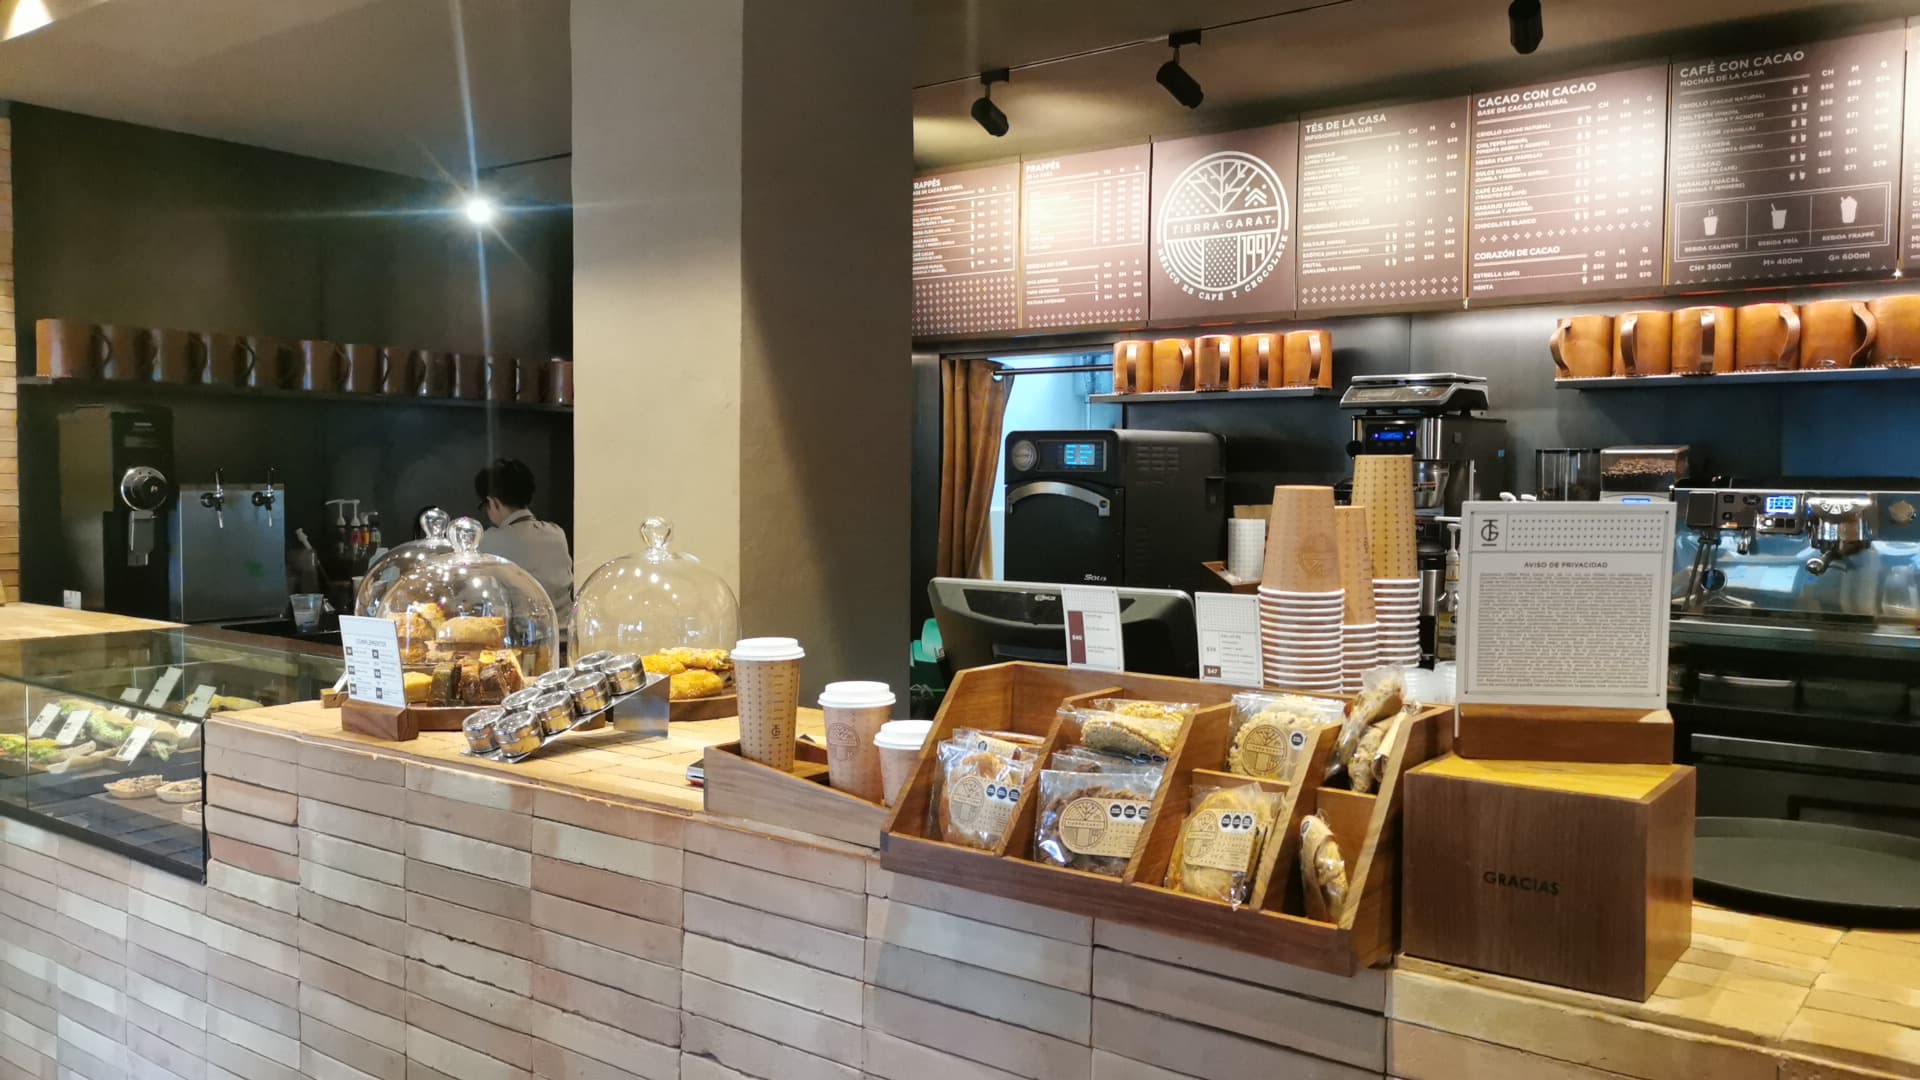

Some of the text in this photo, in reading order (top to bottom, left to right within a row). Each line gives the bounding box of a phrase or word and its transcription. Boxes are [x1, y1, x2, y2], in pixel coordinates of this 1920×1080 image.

[1680, 51, 1804, 78] CAFÉ CON CACAO
[1821, 68, 1834, 77] CH
[1851, 64, 1859, 72] M
[1680, 69, 1765, 87] MOCHAS DE LA CASA
[1478, 82, 1597, 108] CACAO CON CACAO
[1477, 97, 1569, 117] BASE DE CACAO NATURAL
[1305, 113, 1387, 134] TÉS DE LA CASA
[1408, 127, 1418, 135] CH
[1025, 160, 1061, 173] FRAPPÉS
[912, 177, 941, 190] RAPPÉS
[1173, 220, 1220, 235] TIERRA
[1822, 229, 1875, 242] BEBIDA FRAPPÉ
[1684, 242, 1739, 253] BEBIDA CALIENTE
[1757, 239, 1781, 248] BEBIDA
[1241, 233, 1272, 279] 1991
[1474, 245, 1560, 261] CORAZÓN DE CACAO
[1473, 283, 1494, 292] MENTA
[1199, 290, 1225, 302] CAFÉ
[1548, 562, 1560, 570] DE
[1561, 562, 1609, 570] PRIVACIDAD
[1482, 871, 1561, 897] GRACIAS
